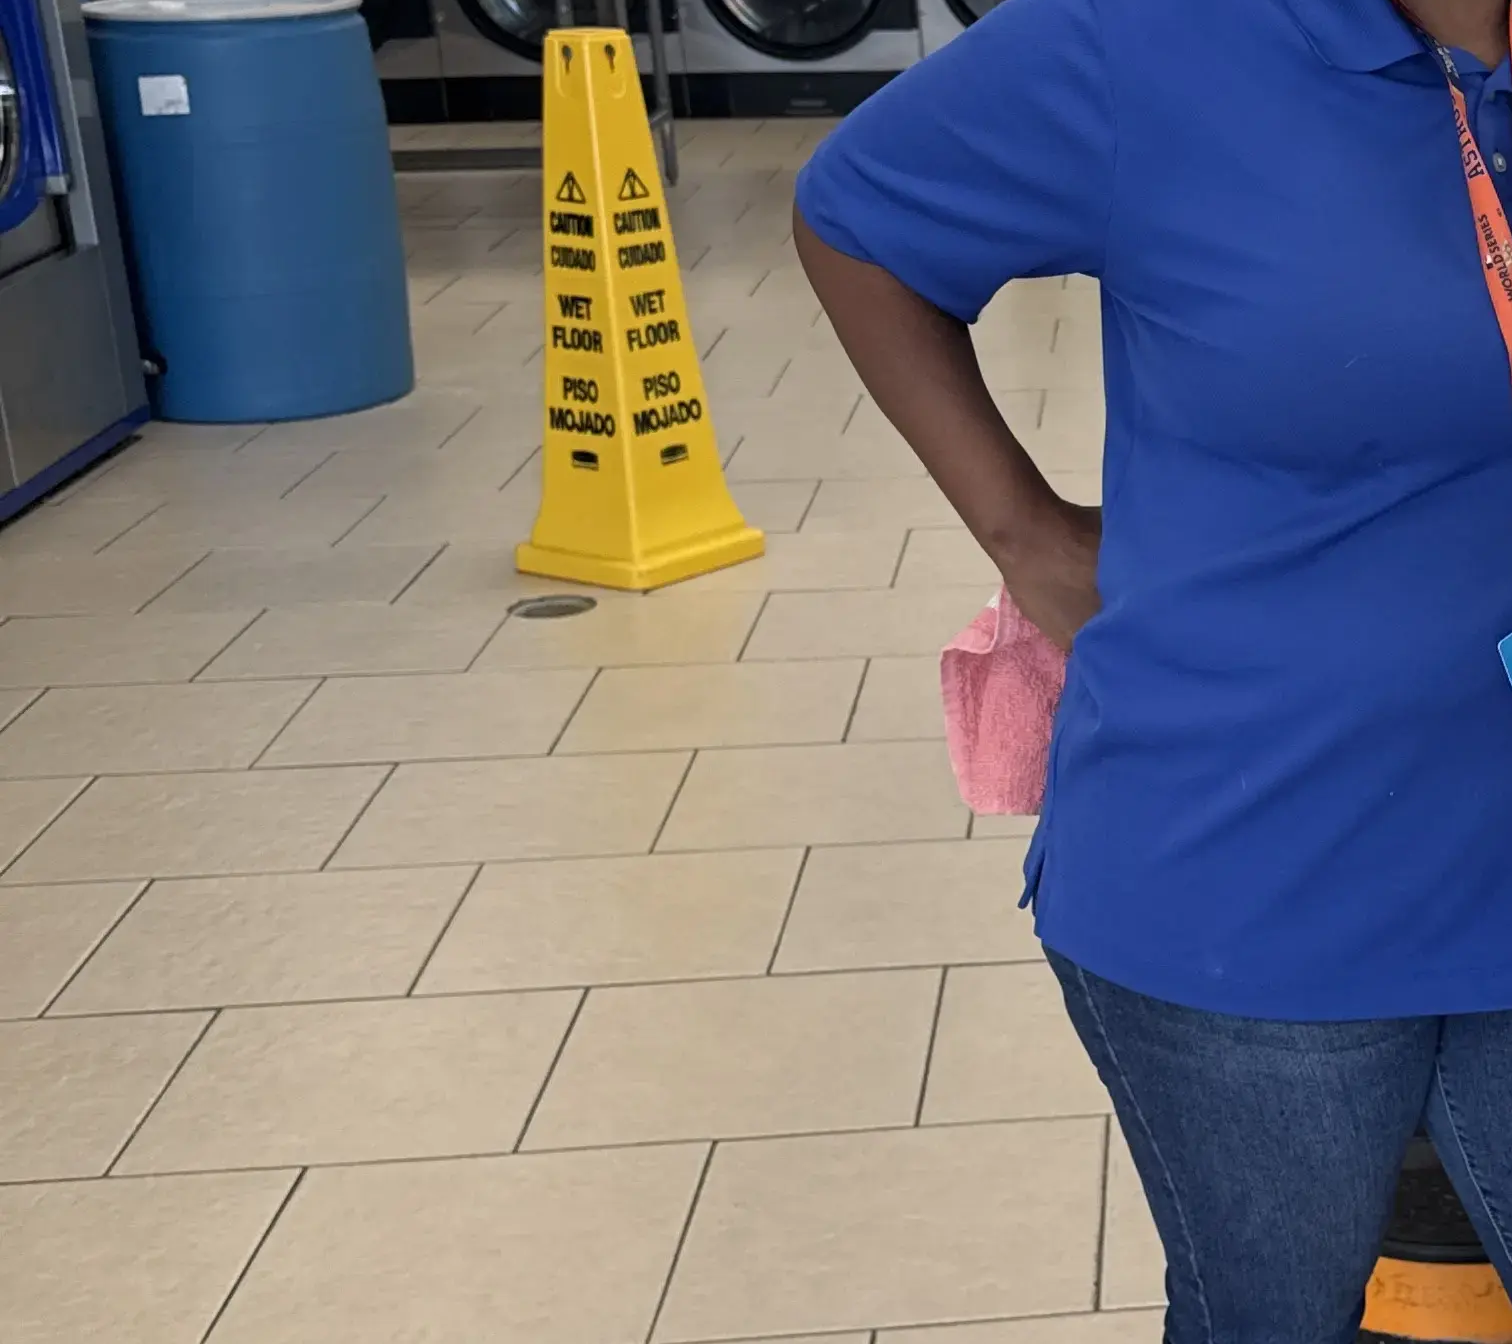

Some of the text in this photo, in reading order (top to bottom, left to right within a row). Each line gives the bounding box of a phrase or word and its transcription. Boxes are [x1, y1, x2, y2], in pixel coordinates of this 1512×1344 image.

[550, 211, 594, 238] CAUTION
[613, 207, 661, 235] CAUTION
[1477, 214, 1500, 254] SERIES
[551, 245, 596, 272] CUIDADO
[618, 240, 666, 270] CUIDADO
[558, 293, 592, 321] WET
[629, 289, 665, 318] WET
[552, 325, 603, 354] FLOOR
[626, 319, 681, 352] FLOOR
[563, 376, 599, 404] PISO
[643, 370, 681, 401] PISO
[549, 407, 616, 438] MOJADO
[633, 398, 702, 437] MOJADO
